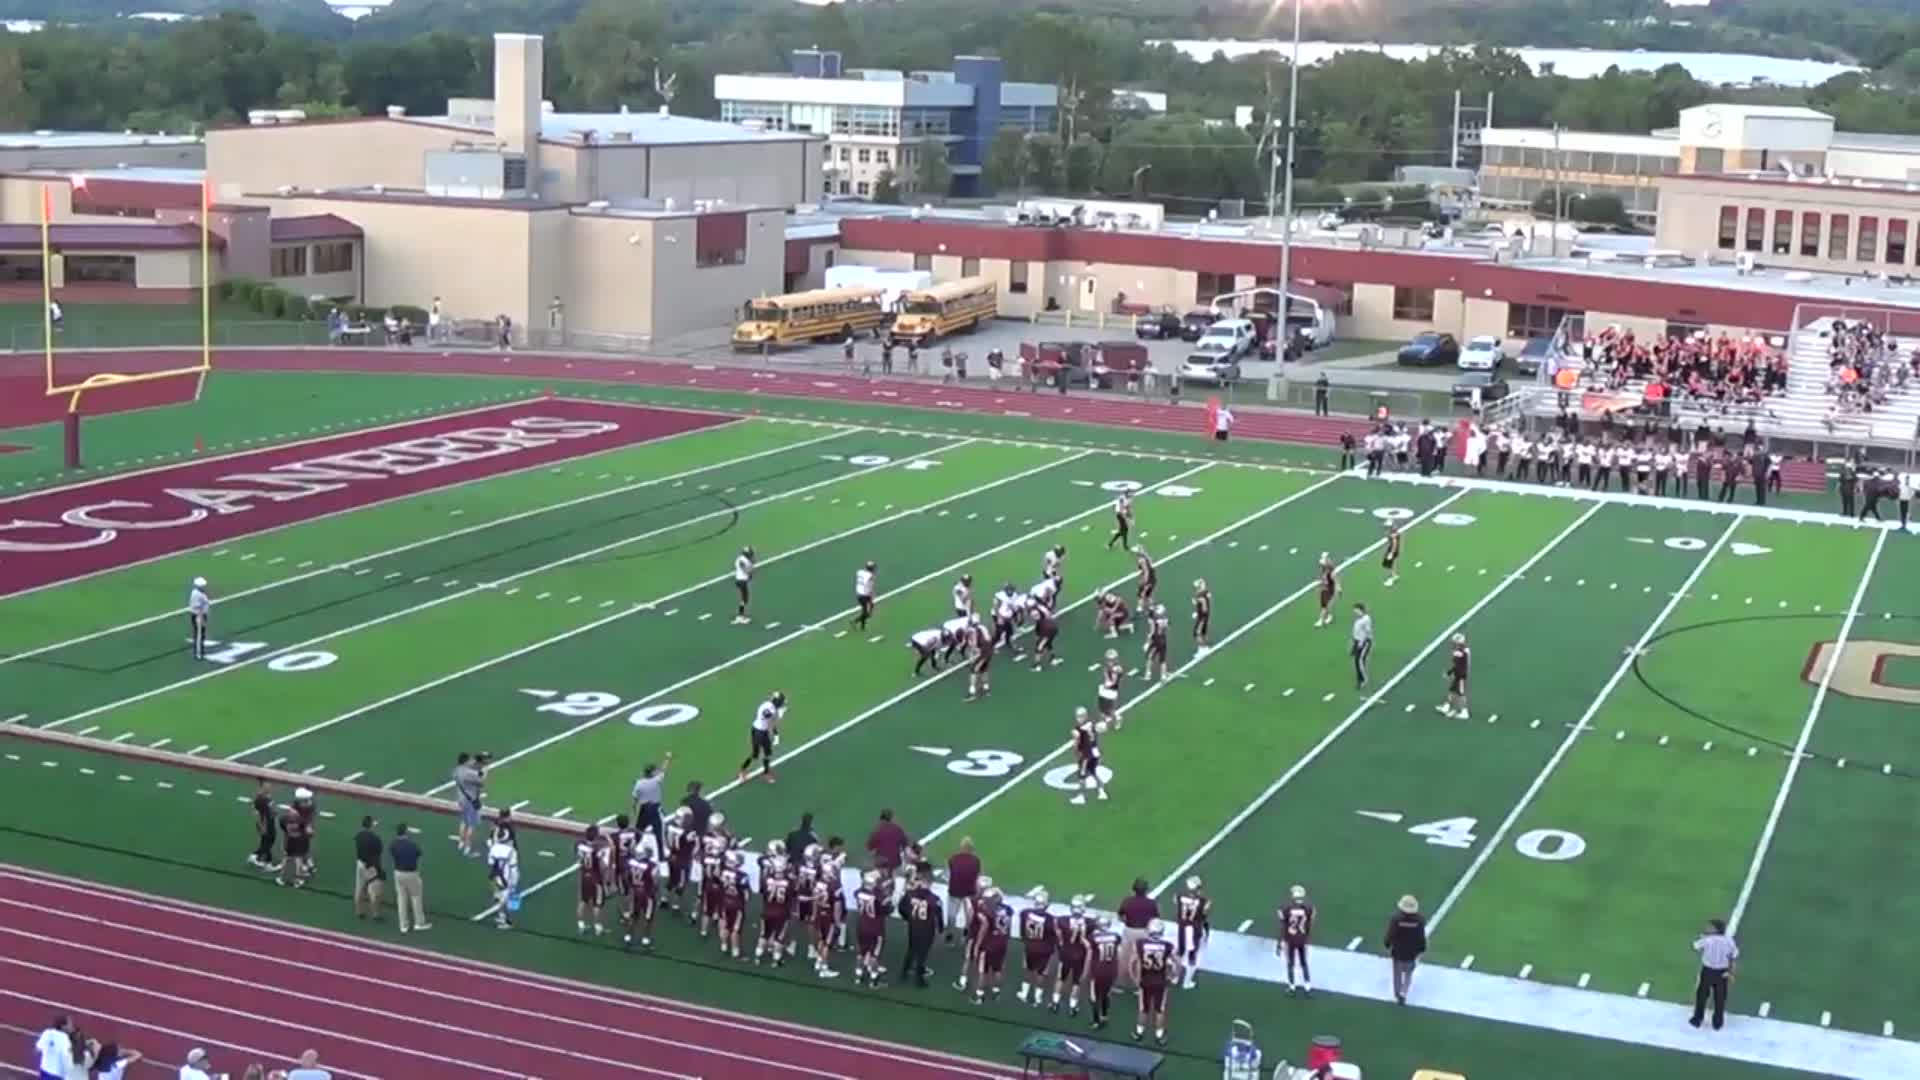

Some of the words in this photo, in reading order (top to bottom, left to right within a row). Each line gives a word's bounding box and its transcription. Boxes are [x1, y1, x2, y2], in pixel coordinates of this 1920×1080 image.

[535, 691, 700, 727] 20
[946, 749, 1114, 790] 30
[1407, 816, 1587, 861] 40
[1141, 950, 1166, 970] 53
